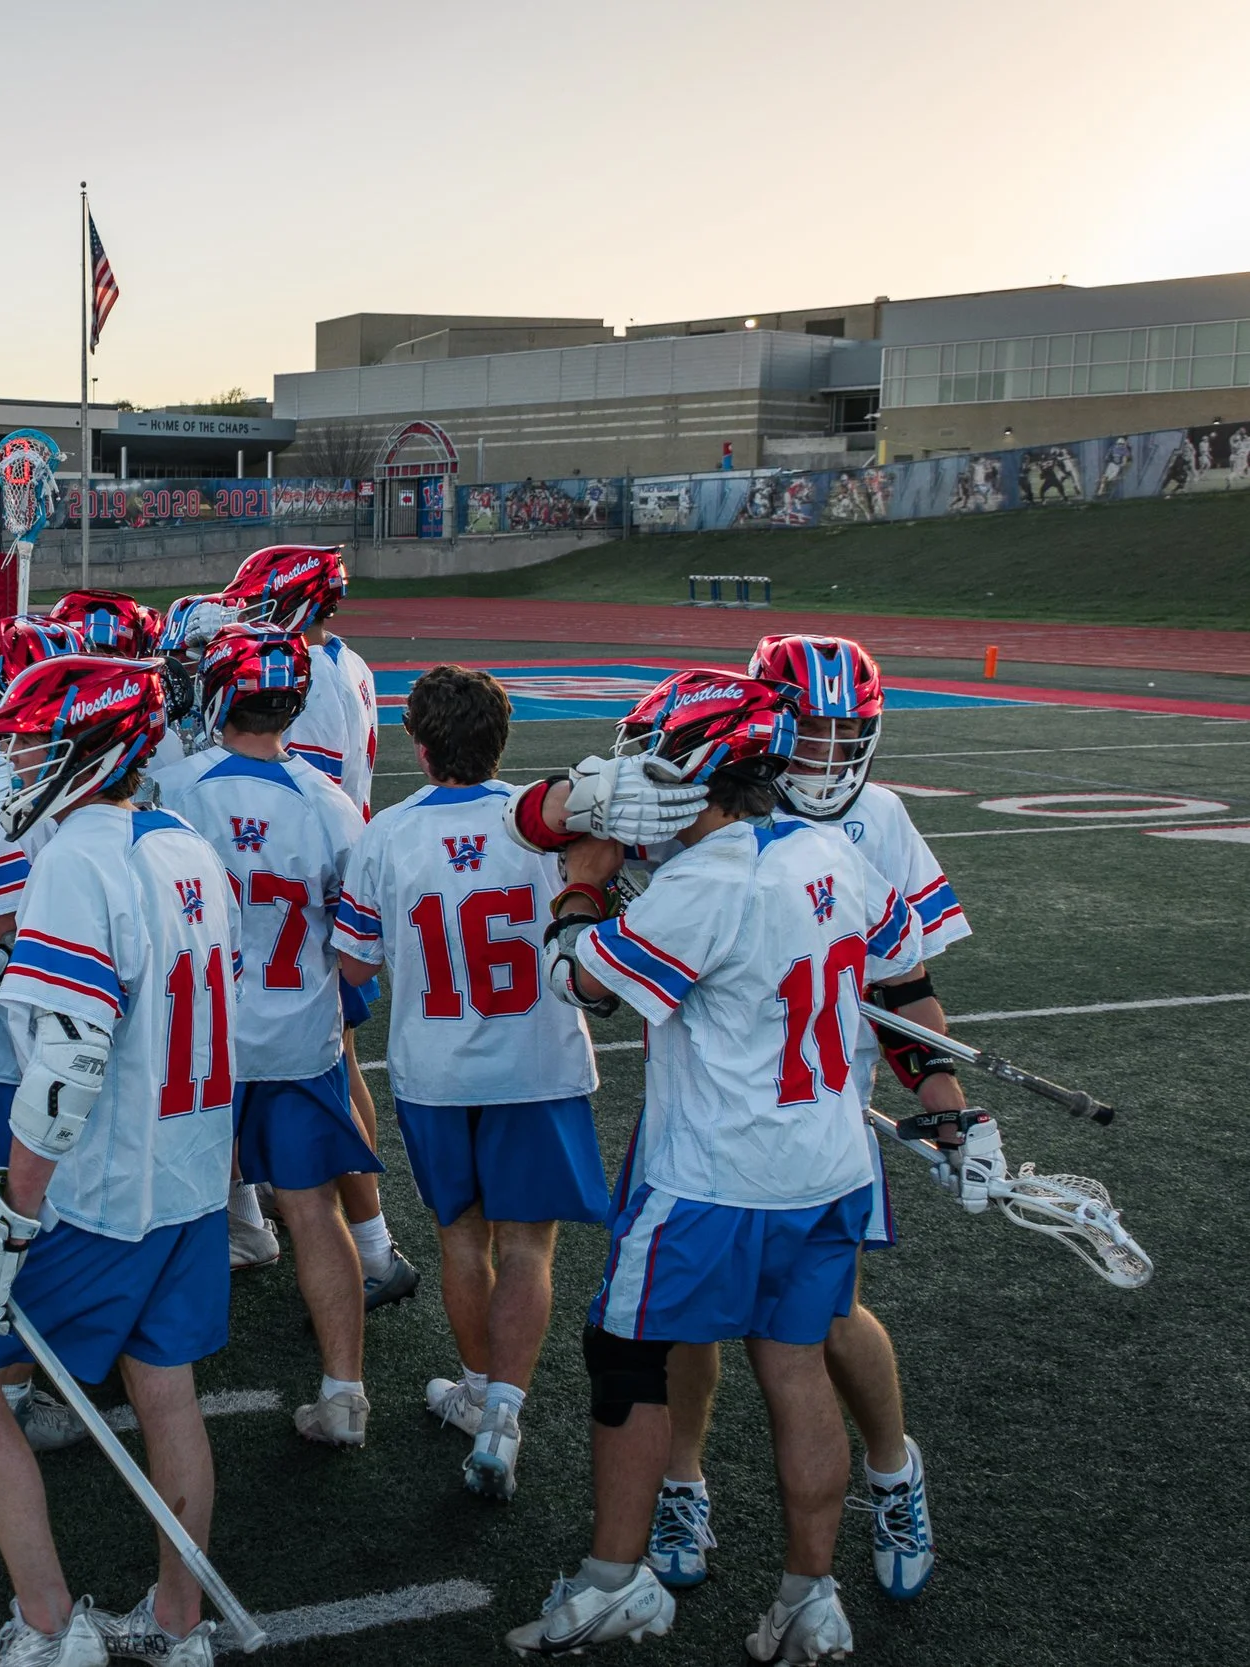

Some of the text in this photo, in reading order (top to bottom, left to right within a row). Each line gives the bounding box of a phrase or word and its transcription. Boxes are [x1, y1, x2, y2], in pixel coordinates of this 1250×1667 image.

[151, 420, 249, 434] HOME OF THE CHAPS
[69, 491, 127, 518] 2019
[143, 490, 200, 518] 2020
[216, 489, 269, 517] 2021
[273, 555, 321, 592] Westlake
[69, 679, 141, 725] Westlake
[408, 884, 540, 1020] 16
[158, 943, 232, 1120] 11
[774, 932, 867, 1108] 10
